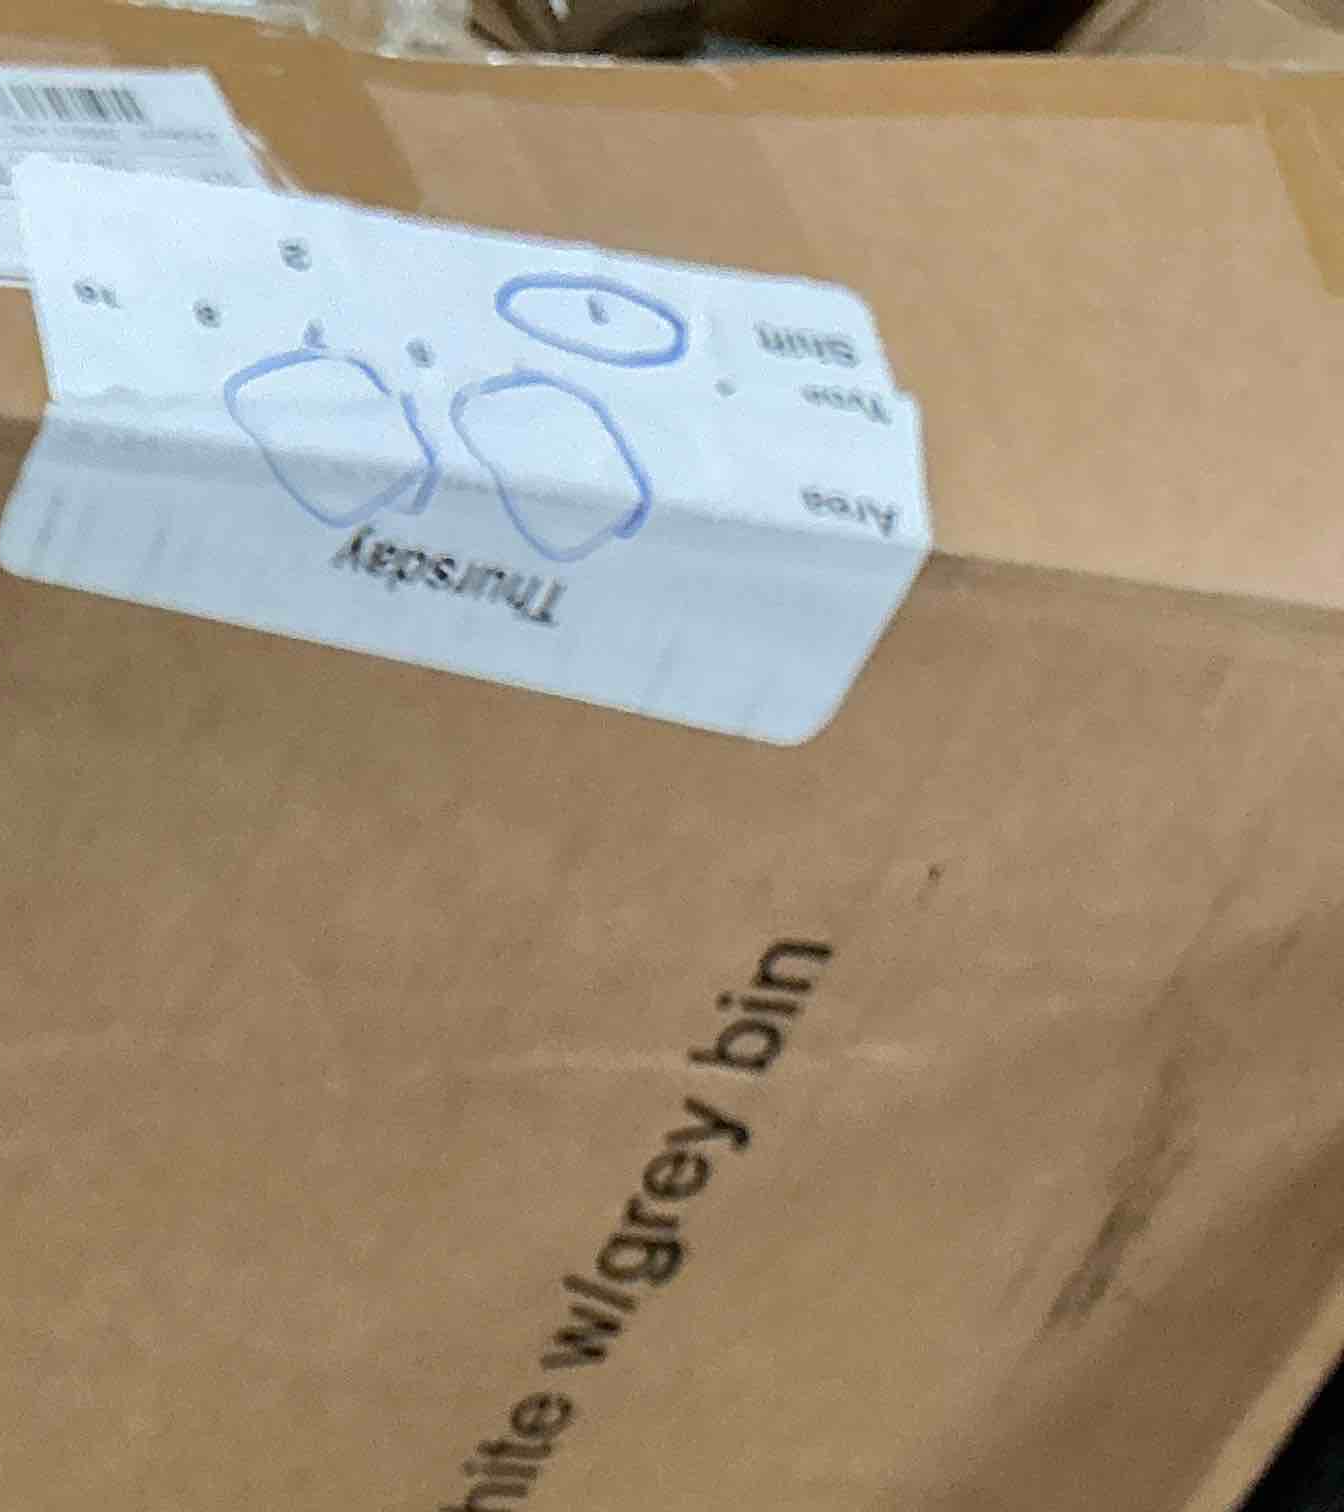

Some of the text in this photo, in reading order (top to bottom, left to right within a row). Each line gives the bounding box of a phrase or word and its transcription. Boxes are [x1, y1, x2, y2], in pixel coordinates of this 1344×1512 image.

[800, 486, 898, 536] Area
[331, 524, 564, 627] Thursday
[539, 1095, 752, 1372] w/grey
[688, 935, 838, 1077] bin
